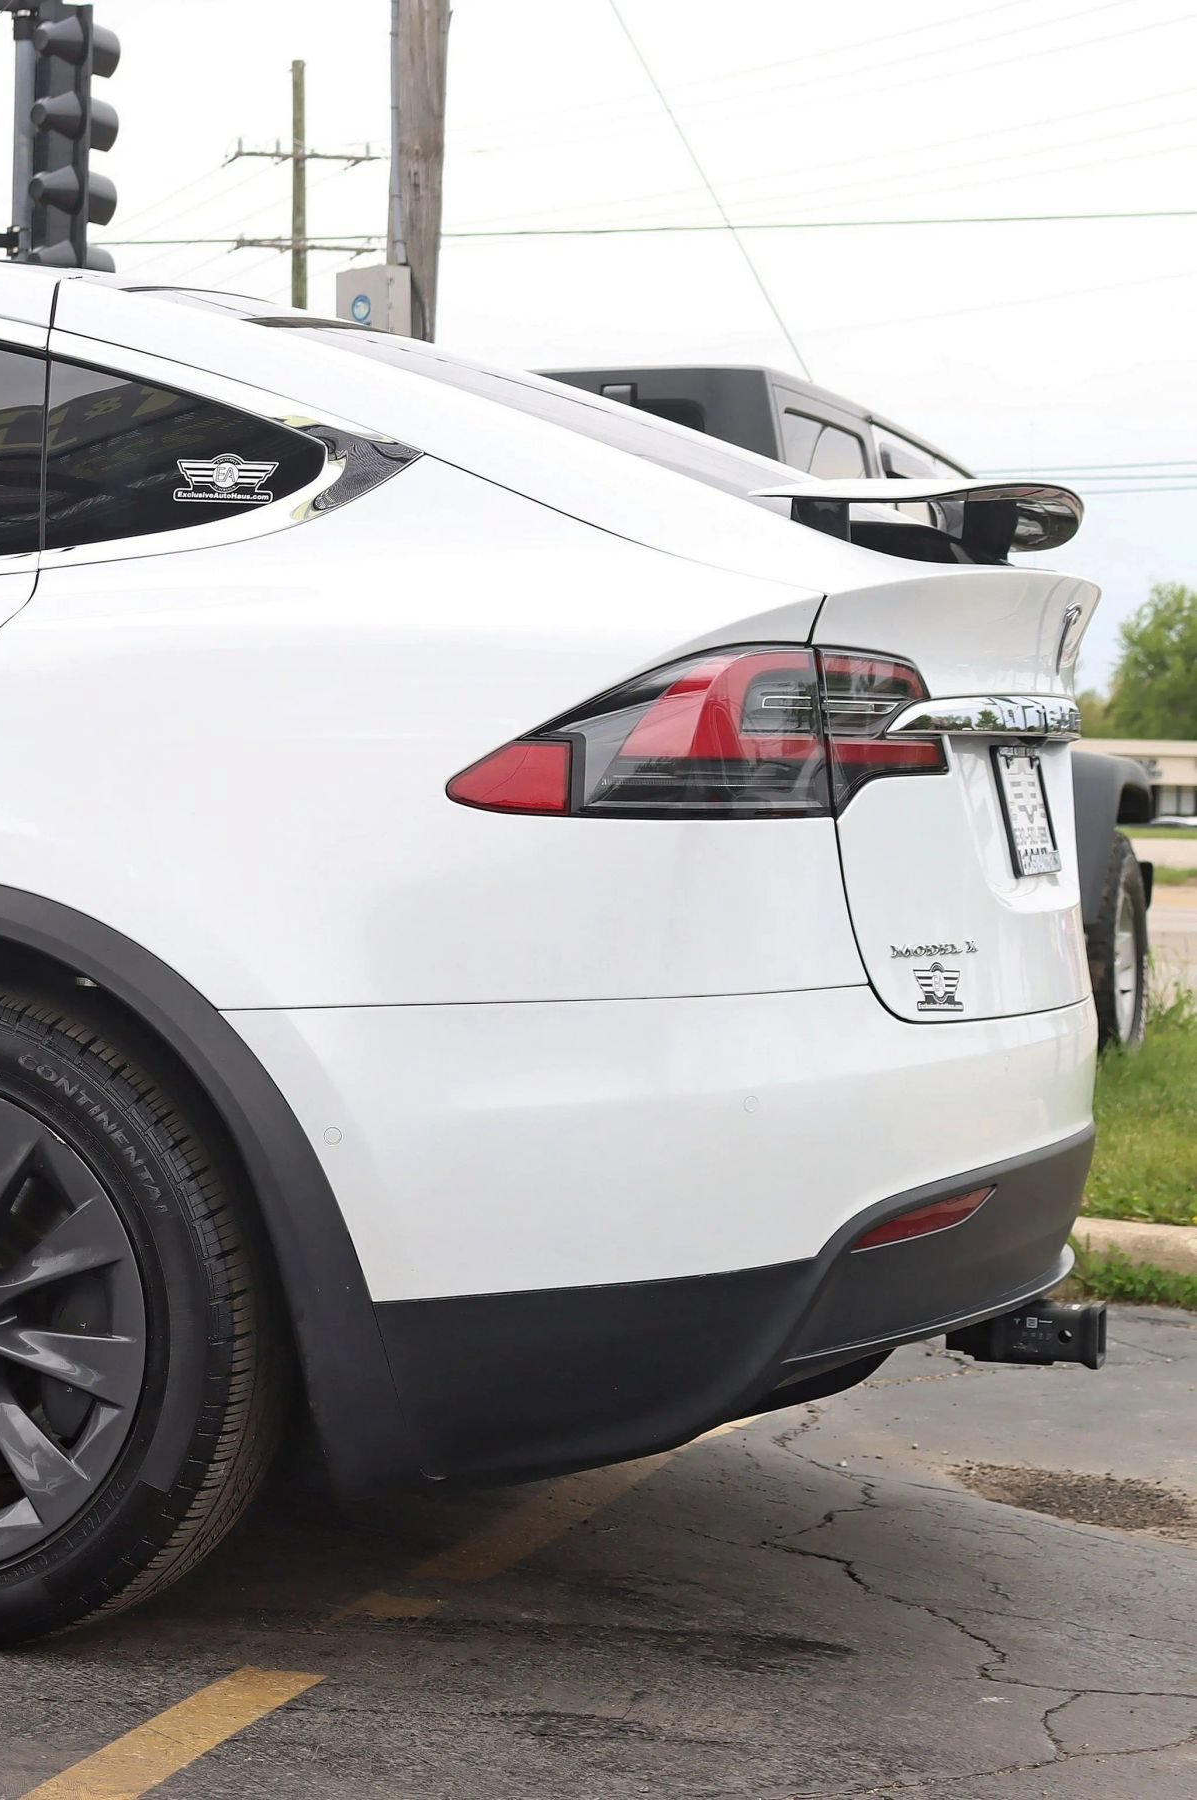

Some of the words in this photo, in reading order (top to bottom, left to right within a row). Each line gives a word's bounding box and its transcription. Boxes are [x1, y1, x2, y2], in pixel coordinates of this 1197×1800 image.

[177, 491, 269, 500] ExclusiveAutoHaus.com
[890, 944, 963, 958] MODEL
[964, 940, 979, 954] X
